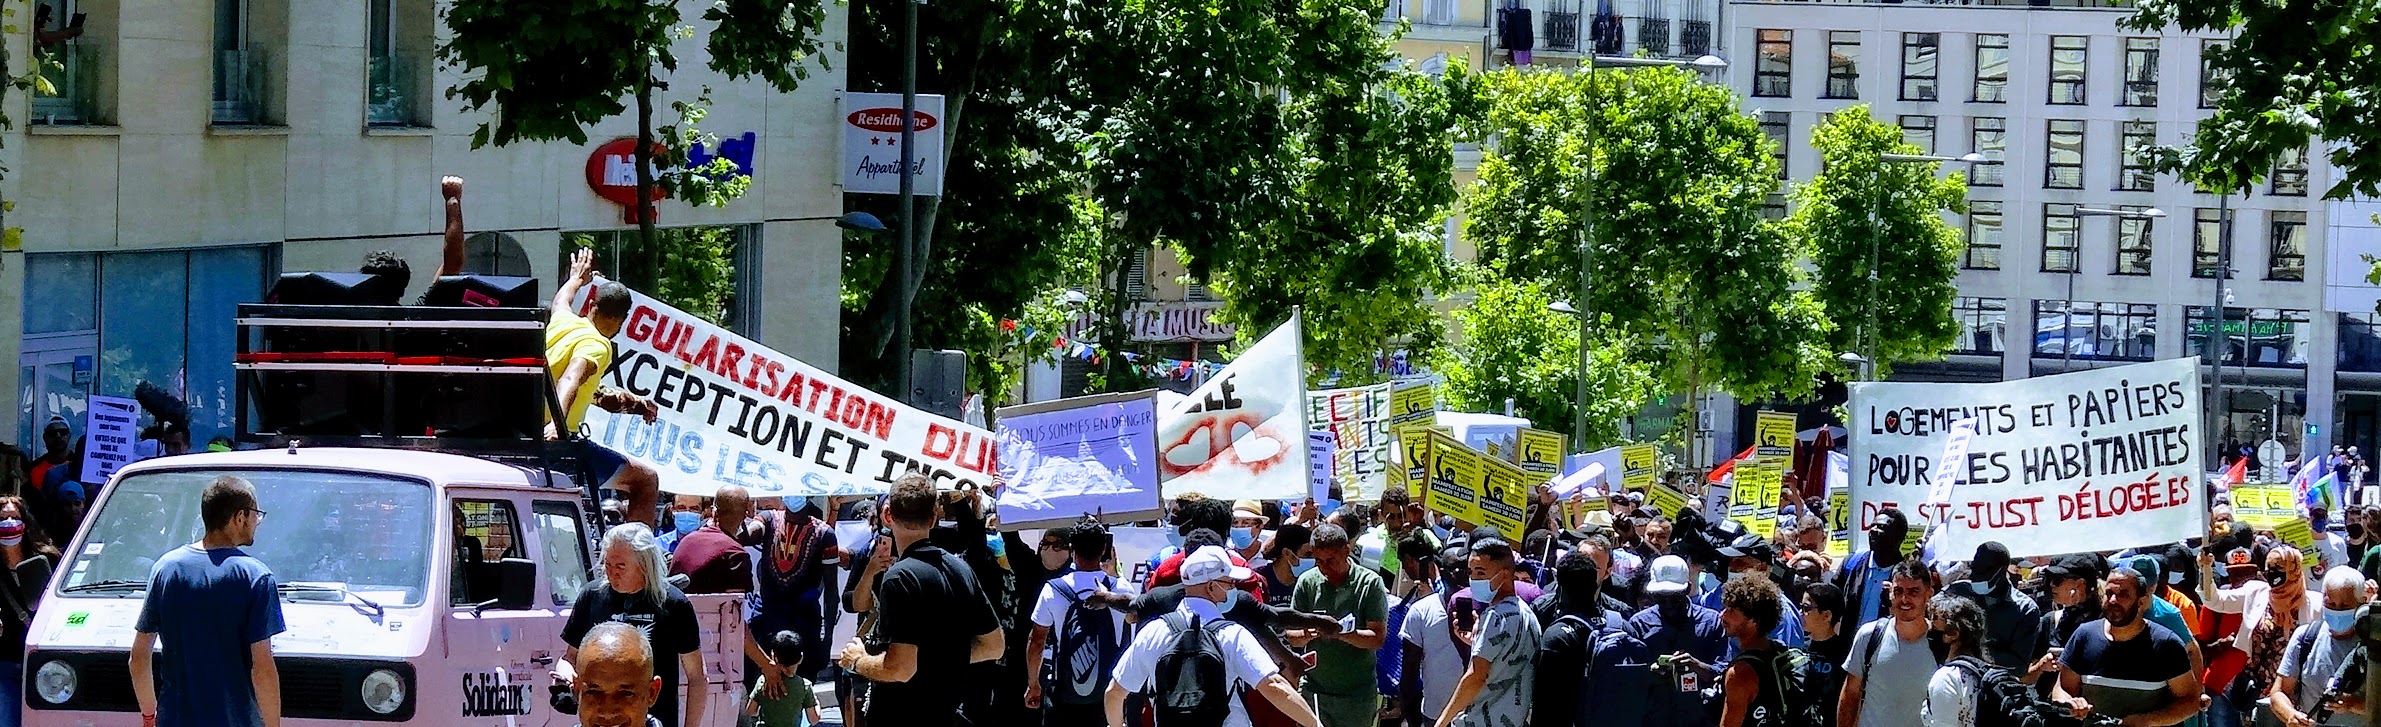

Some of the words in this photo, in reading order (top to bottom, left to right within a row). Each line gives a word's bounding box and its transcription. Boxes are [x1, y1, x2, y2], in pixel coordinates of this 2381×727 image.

[857, 112, 928, 127] Residhme
[578, 284, 897, 442] GULARISATION
[600, 341, 813, 459] XCEPTION
[814, 428, 870, 474] ET
[1048, 418, 1091, 441] SOMMES
[1093, 417, 1109, 432] EN
[1871, 404, 2016, 436] LOGEMENTS
[2031, 403, 2055, 427] ET
[2068, 379, 2185, 428] PAPIERS
[602, 412, 705, 475] TOUS
[712, 442, 786, 492] LES
[1867, 453, 1932, 486] POUR
[1918, 497, 2044, 529] ST-JUST
[2058, 471, 2190, 522] DÉLOGÉ.ES
[1070, 635, 1098, 681] NIKE
